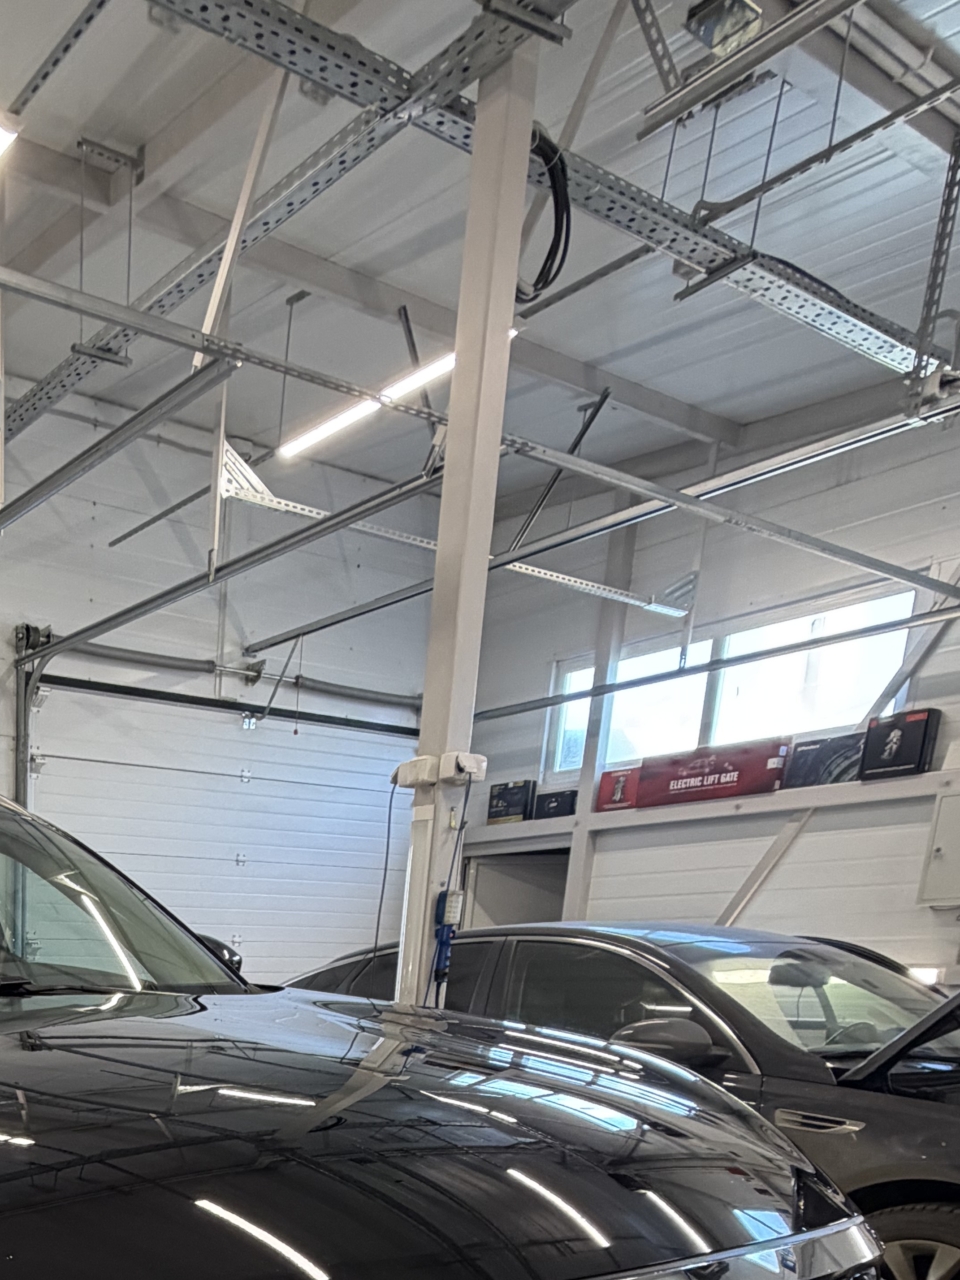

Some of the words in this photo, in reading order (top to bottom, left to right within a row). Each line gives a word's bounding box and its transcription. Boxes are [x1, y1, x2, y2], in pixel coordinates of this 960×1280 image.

[669, 776, 703, 791] ELECTRIC
[703, 773, 720, 786] LIFT
[720, 771, 740, 784] GATE
